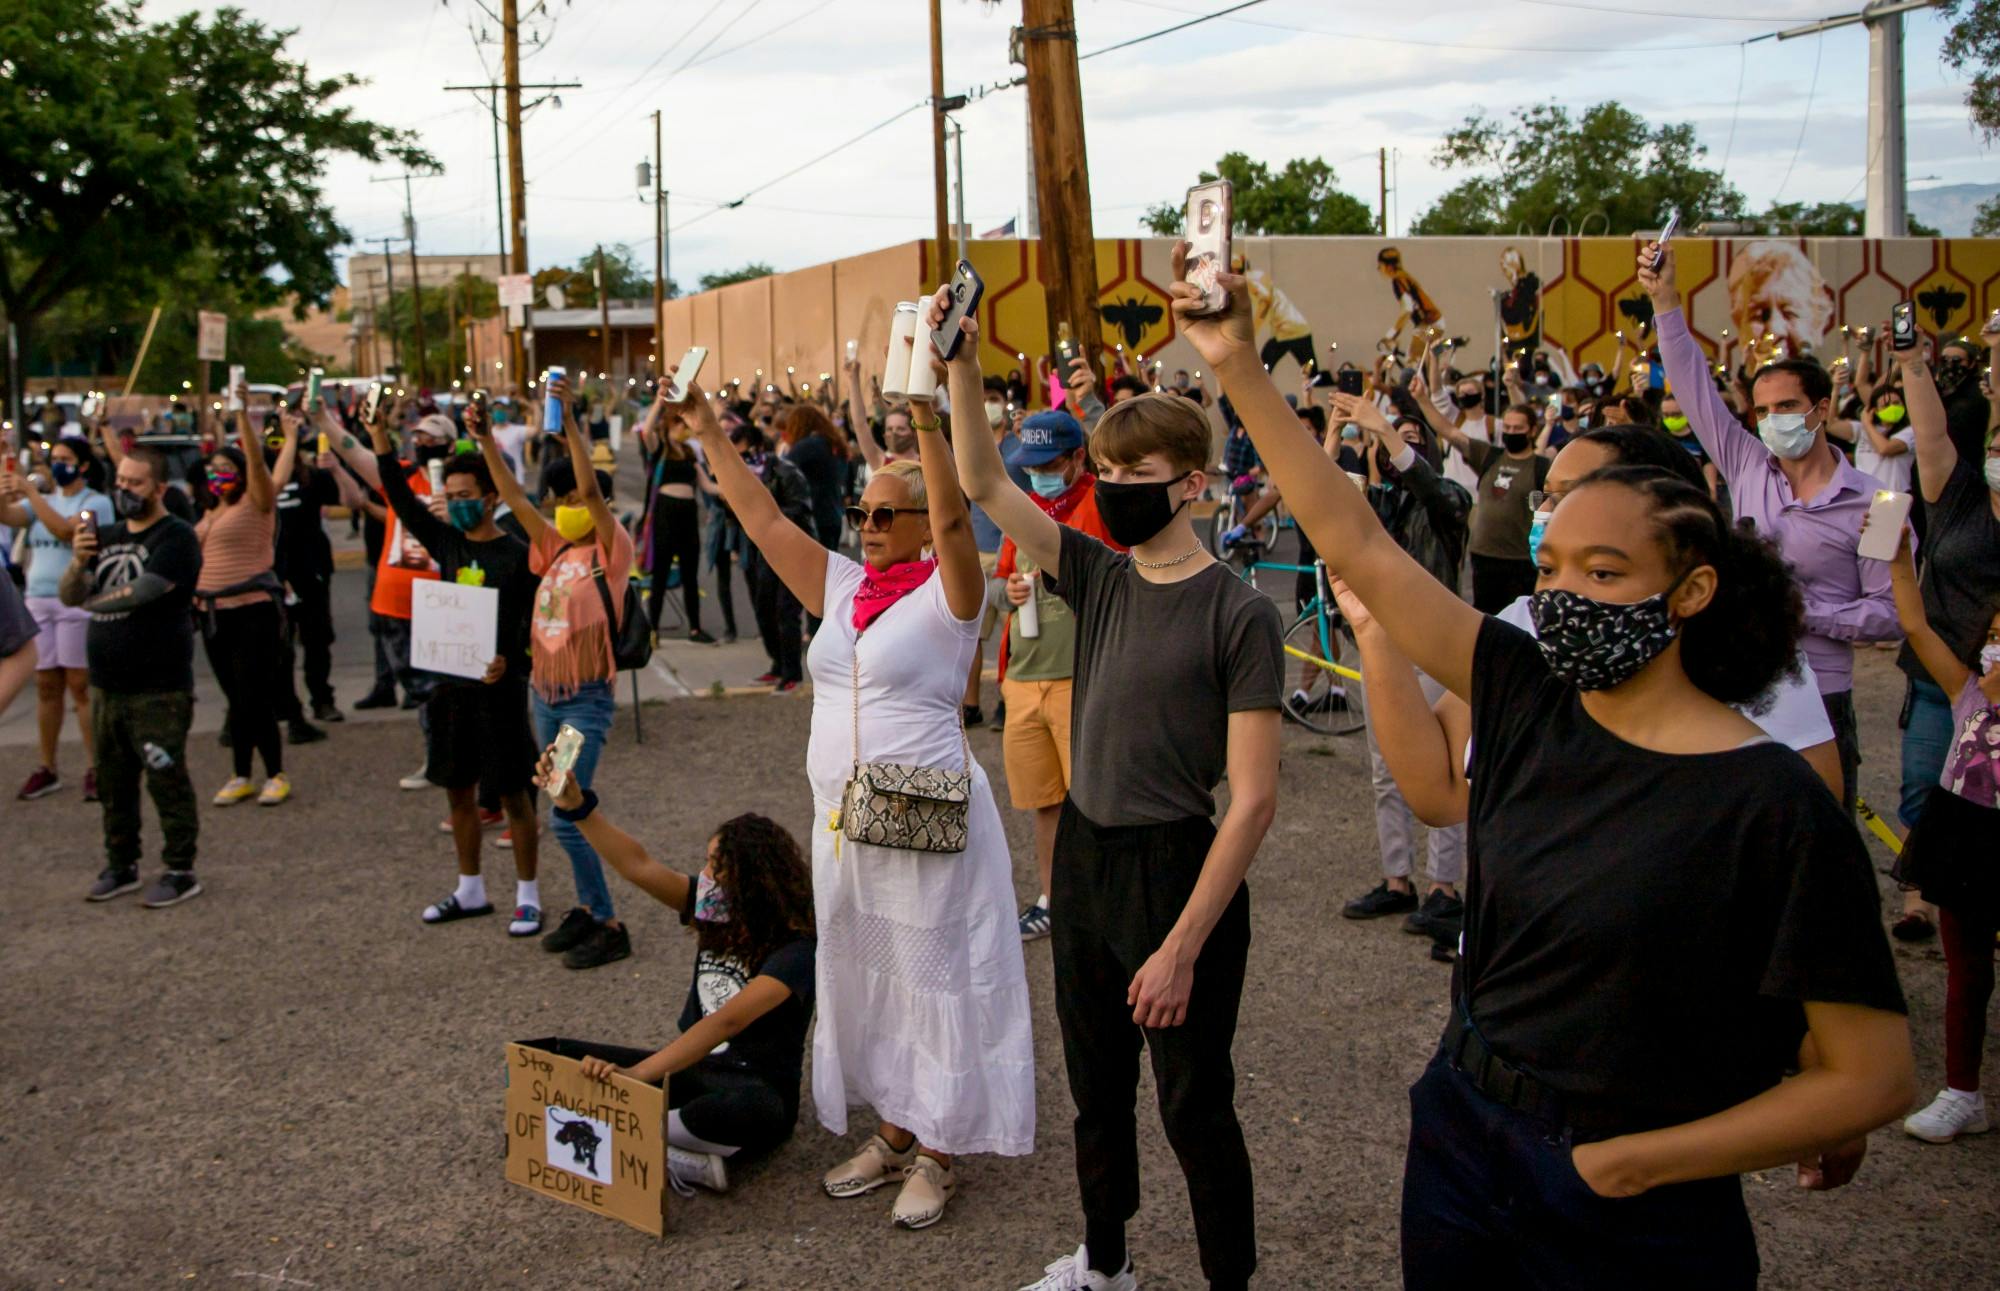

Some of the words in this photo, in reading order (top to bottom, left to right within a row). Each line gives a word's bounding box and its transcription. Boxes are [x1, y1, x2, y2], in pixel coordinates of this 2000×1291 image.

[417, 639, 486, 667] MATTER
[518, 1048, 553, 1080] Stop
[531, 1080, 643, 1141] SLAUGHTER
[515, 1112, 543, 1140] OF
[620, 1150, 648, 1191] MY
[527, 1159, 605, 1206] PEOPLE
